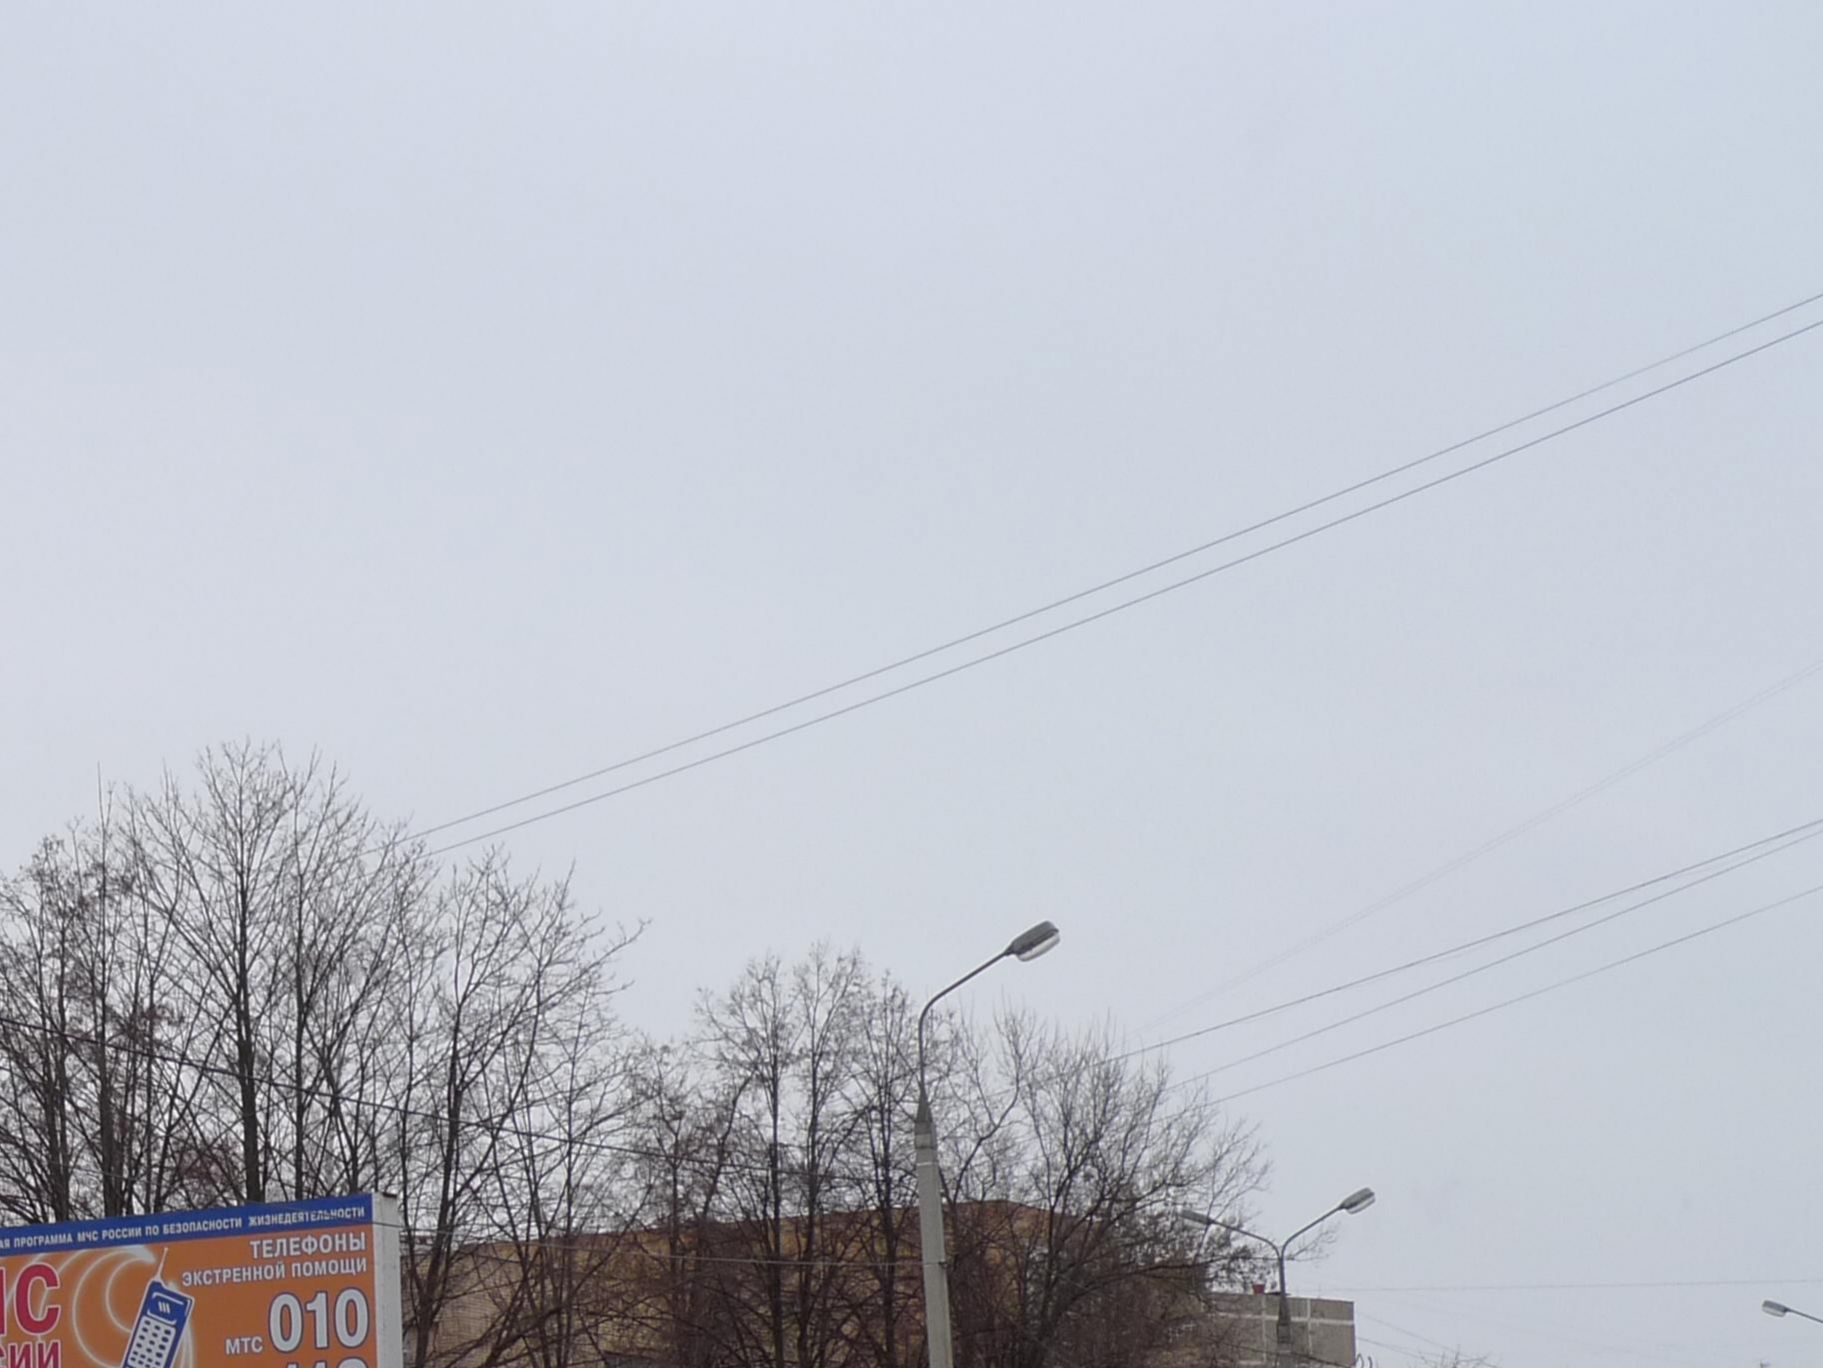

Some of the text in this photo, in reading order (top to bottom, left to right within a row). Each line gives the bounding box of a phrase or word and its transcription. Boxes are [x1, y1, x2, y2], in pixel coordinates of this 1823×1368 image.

[14, 1234, 73, 1247] ПРОГРАММА
[77, 1231, 98, 1242] МЧС
[102, 1226, 142, 1240] РОССИИ
[145, 1225, 159, 1236] ПО
[163, 1217, 243, 1235] БЕЗОПАСНОСТИ
[248, 1206, 365, 1228] ЖИЗНЕДЕЯТЕЛЬНОСТИ
[250, 1232, 366, 1259] ТЕЛЕФОНЫ
[182, 1257, 367, 1287] ЭКСТРЕННОЙ ПОМОЩИ
[225, 1287, 370, 1355] МТС 010
